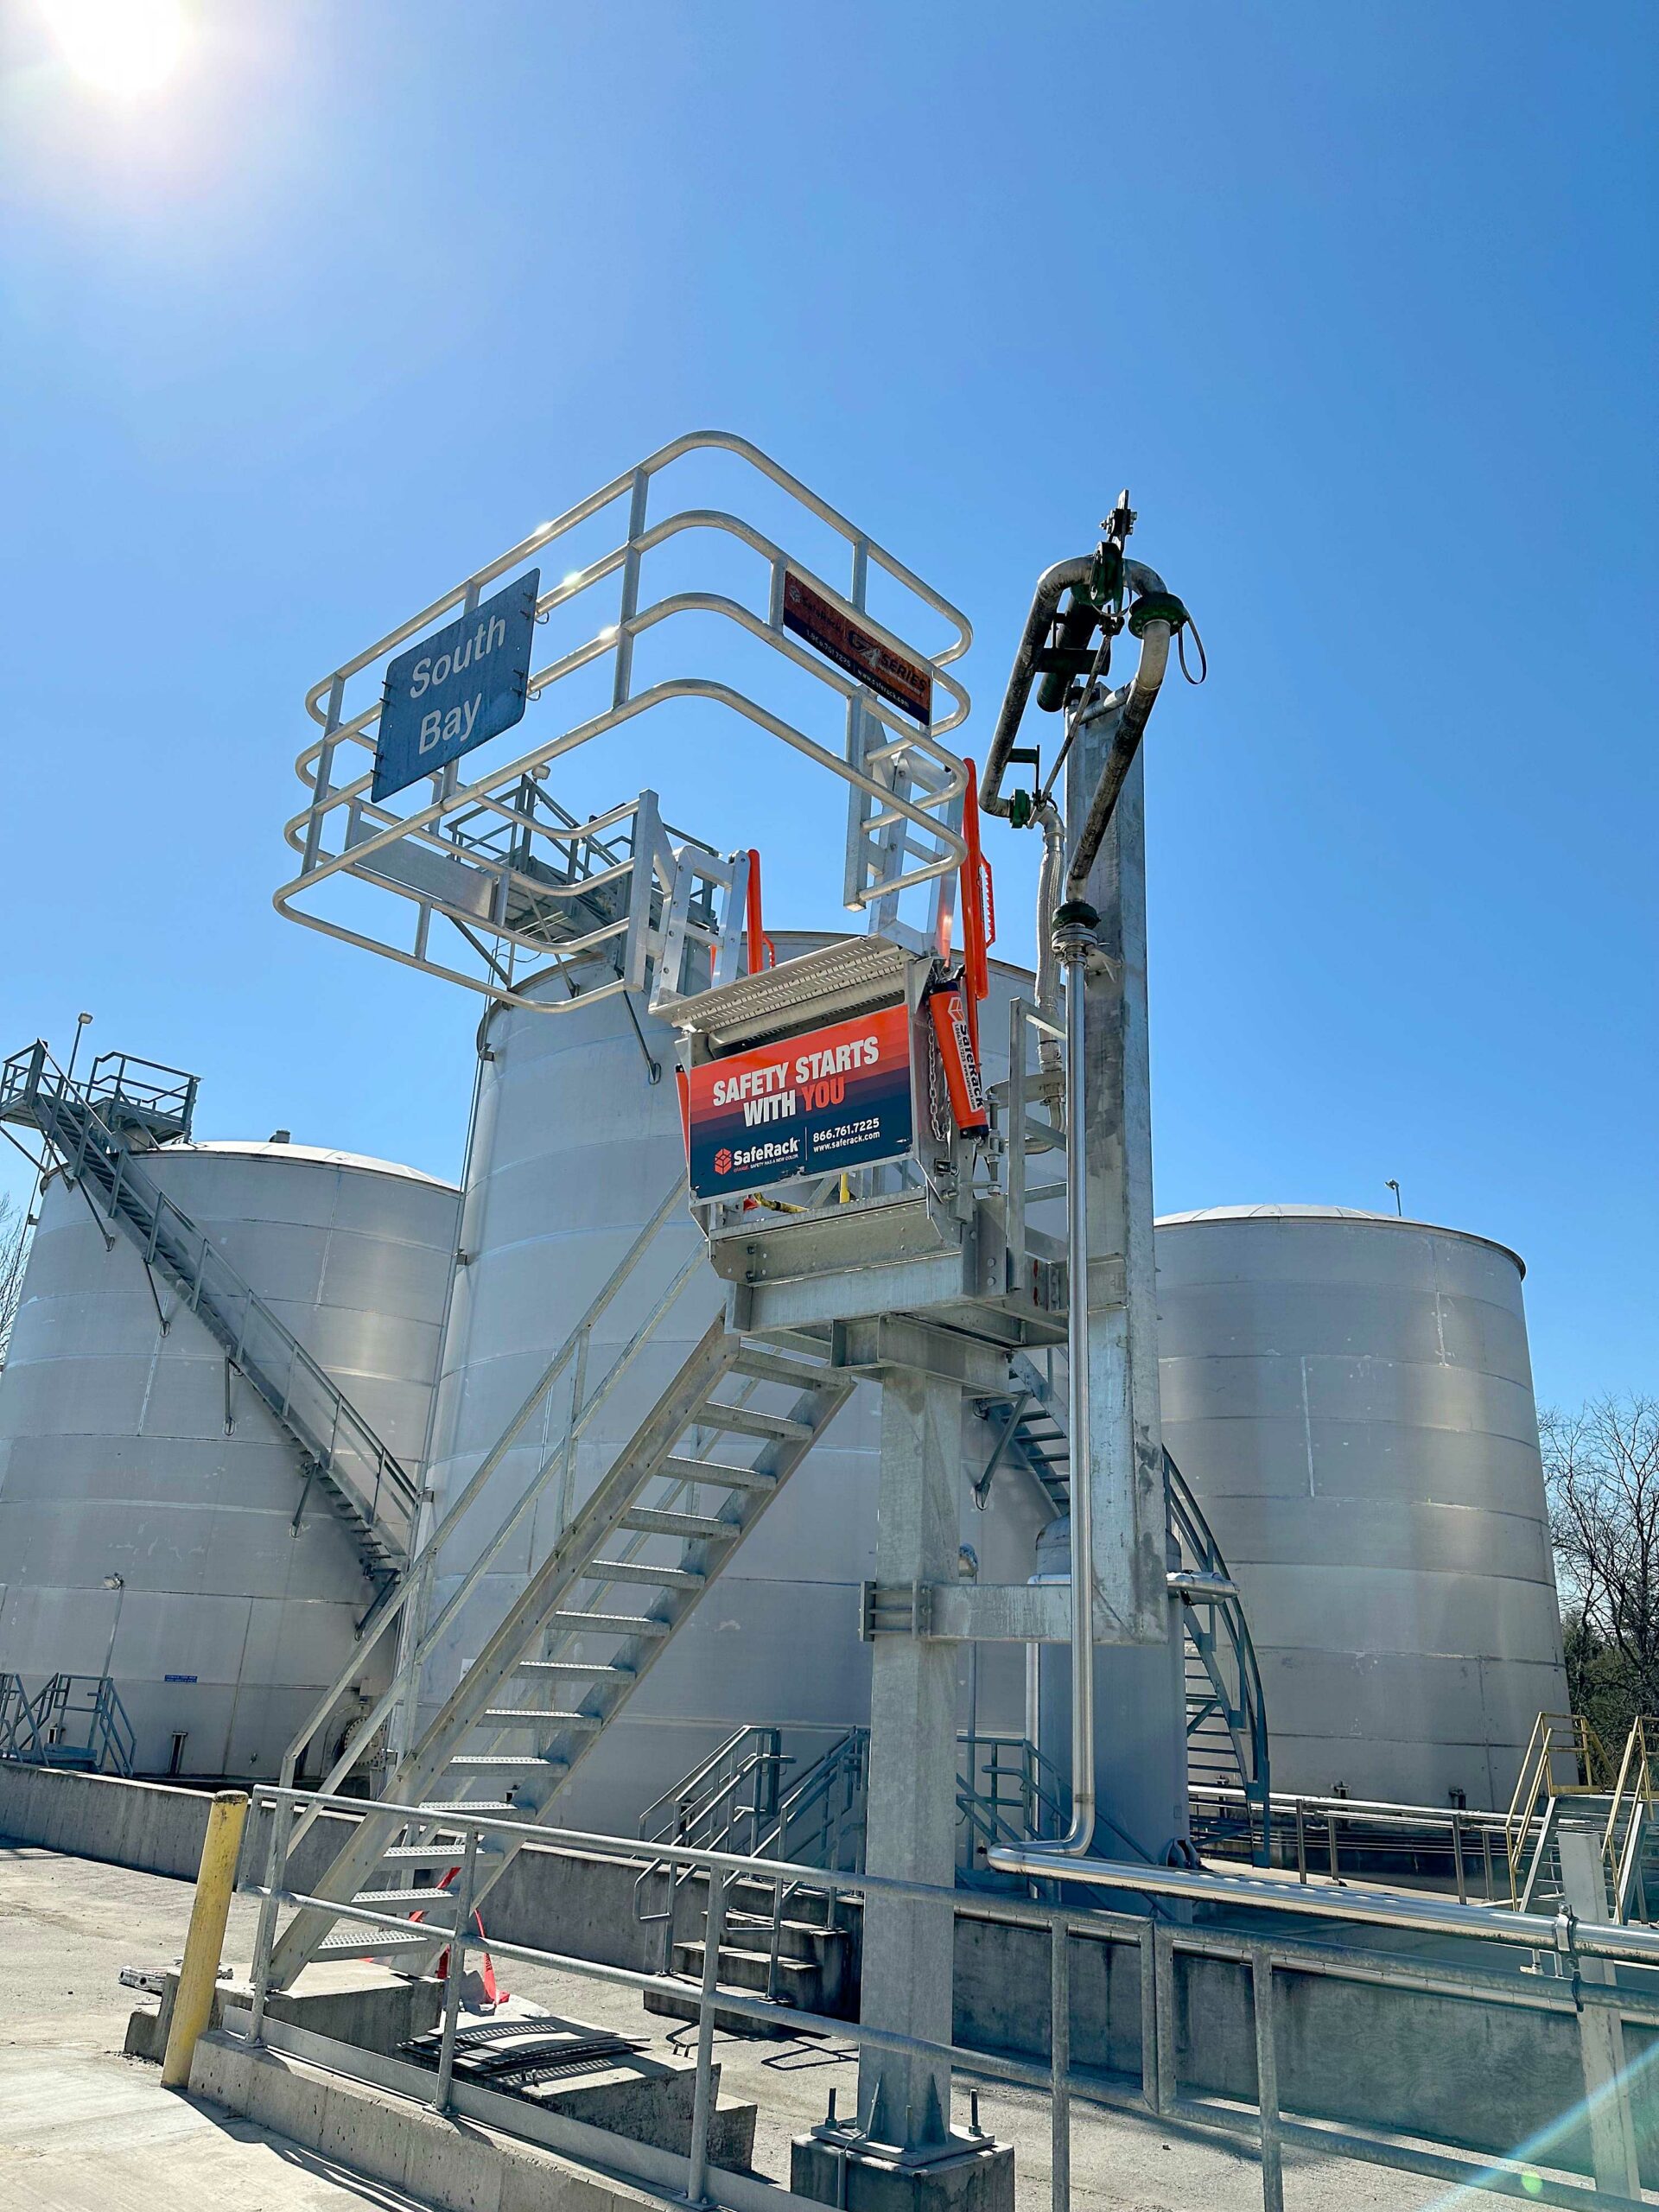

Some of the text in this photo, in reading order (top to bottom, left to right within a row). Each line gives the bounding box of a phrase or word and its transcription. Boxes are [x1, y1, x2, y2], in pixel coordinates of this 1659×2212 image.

[410, 614, 506, 699] South
[881, 652, 926, 692] SERIES
[418, 692, 482, 756] Bay
[713, 1036, 880, 1107] SAFETY STARTS
[743, 1076, 845, 1128] WITH YOU
[734, 1136, 799, 1166] SafeRack
[813, 1117, 880, 1143] 866.761.7225
[813, 1130, 880, 1153] www.saferack.com
